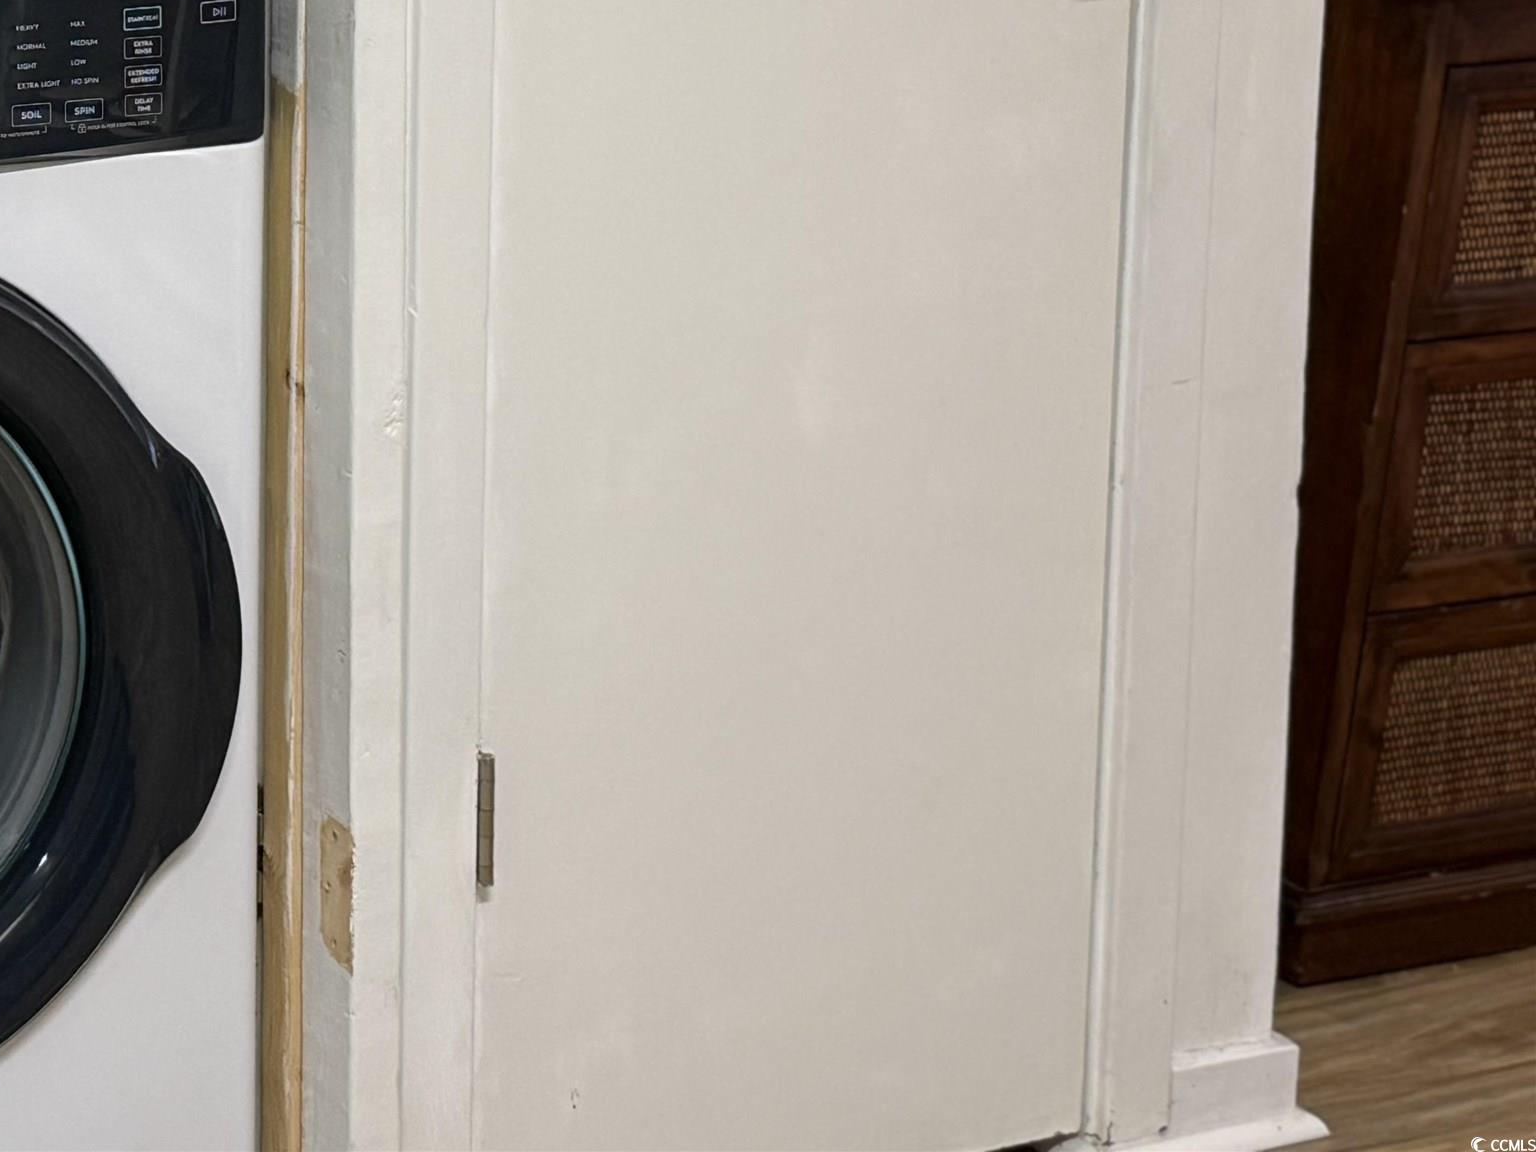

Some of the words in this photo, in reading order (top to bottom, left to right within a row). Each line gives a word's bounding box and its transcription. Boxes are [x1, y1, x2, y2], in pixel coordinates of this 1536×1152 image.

[16, 42, 46, 51] NORMAL
[16, 62, 37, 70] LIGHT
[127, 68, 160, 77] EXTENDED
[17, 81, 39, 90] EXTRA
[40, 79, 61, 88] LIGHT
[84, 76, 100, 85] SPIN
[134, 97, 154, 105] DELAY
[74, 106, 96, 116] SPIN
[137, 104, 151, 112] TIME
[21, 110, 42, 120] SOIL
